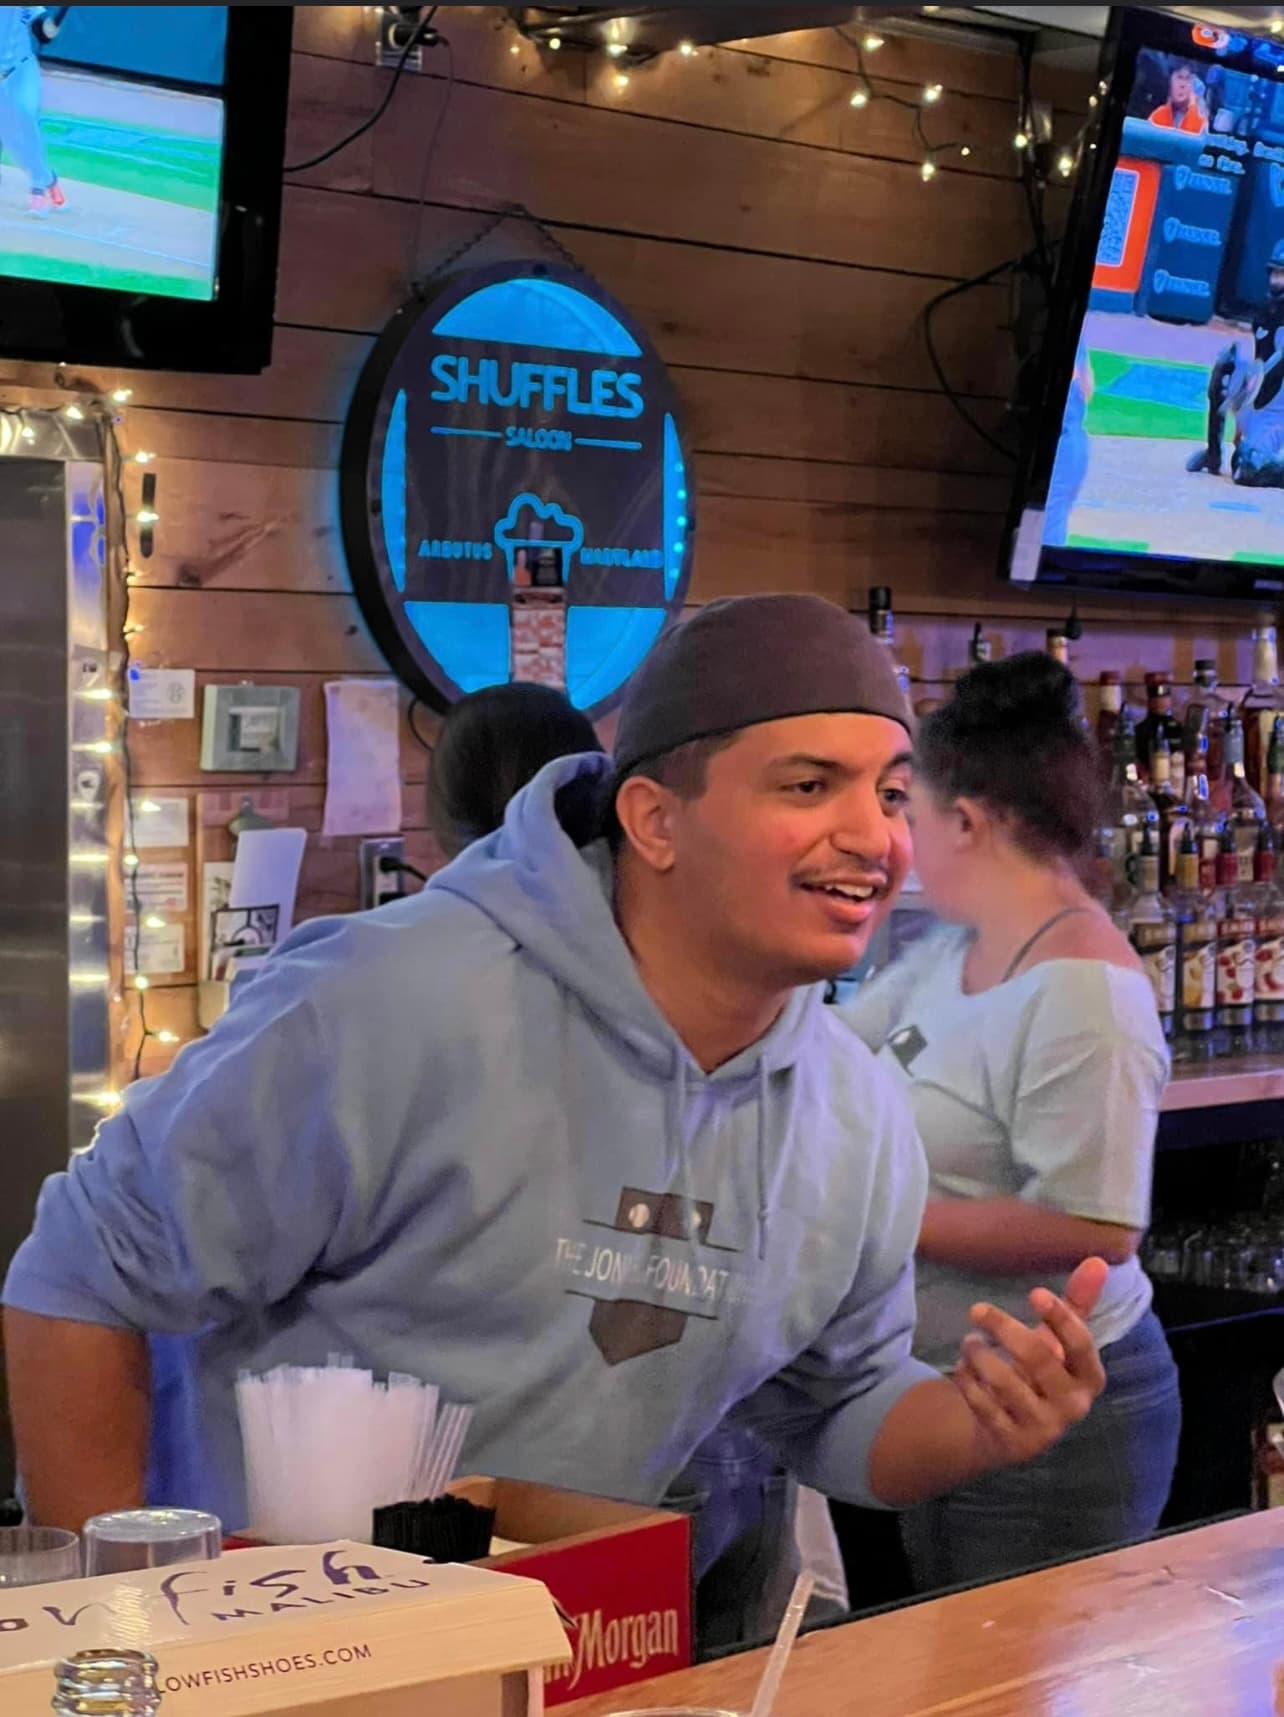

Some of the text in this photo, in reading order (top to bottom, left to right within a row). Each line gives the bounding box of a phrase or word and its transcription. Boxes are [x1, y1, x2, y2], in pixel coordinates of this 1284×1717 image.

[430, 354, 644, 418] SHUFFLES
[504, 425, 572, 451] SALOON
[211, 1579, 431, 1621] MALIBU
[566, 1608, 679, 1691] Morgan
